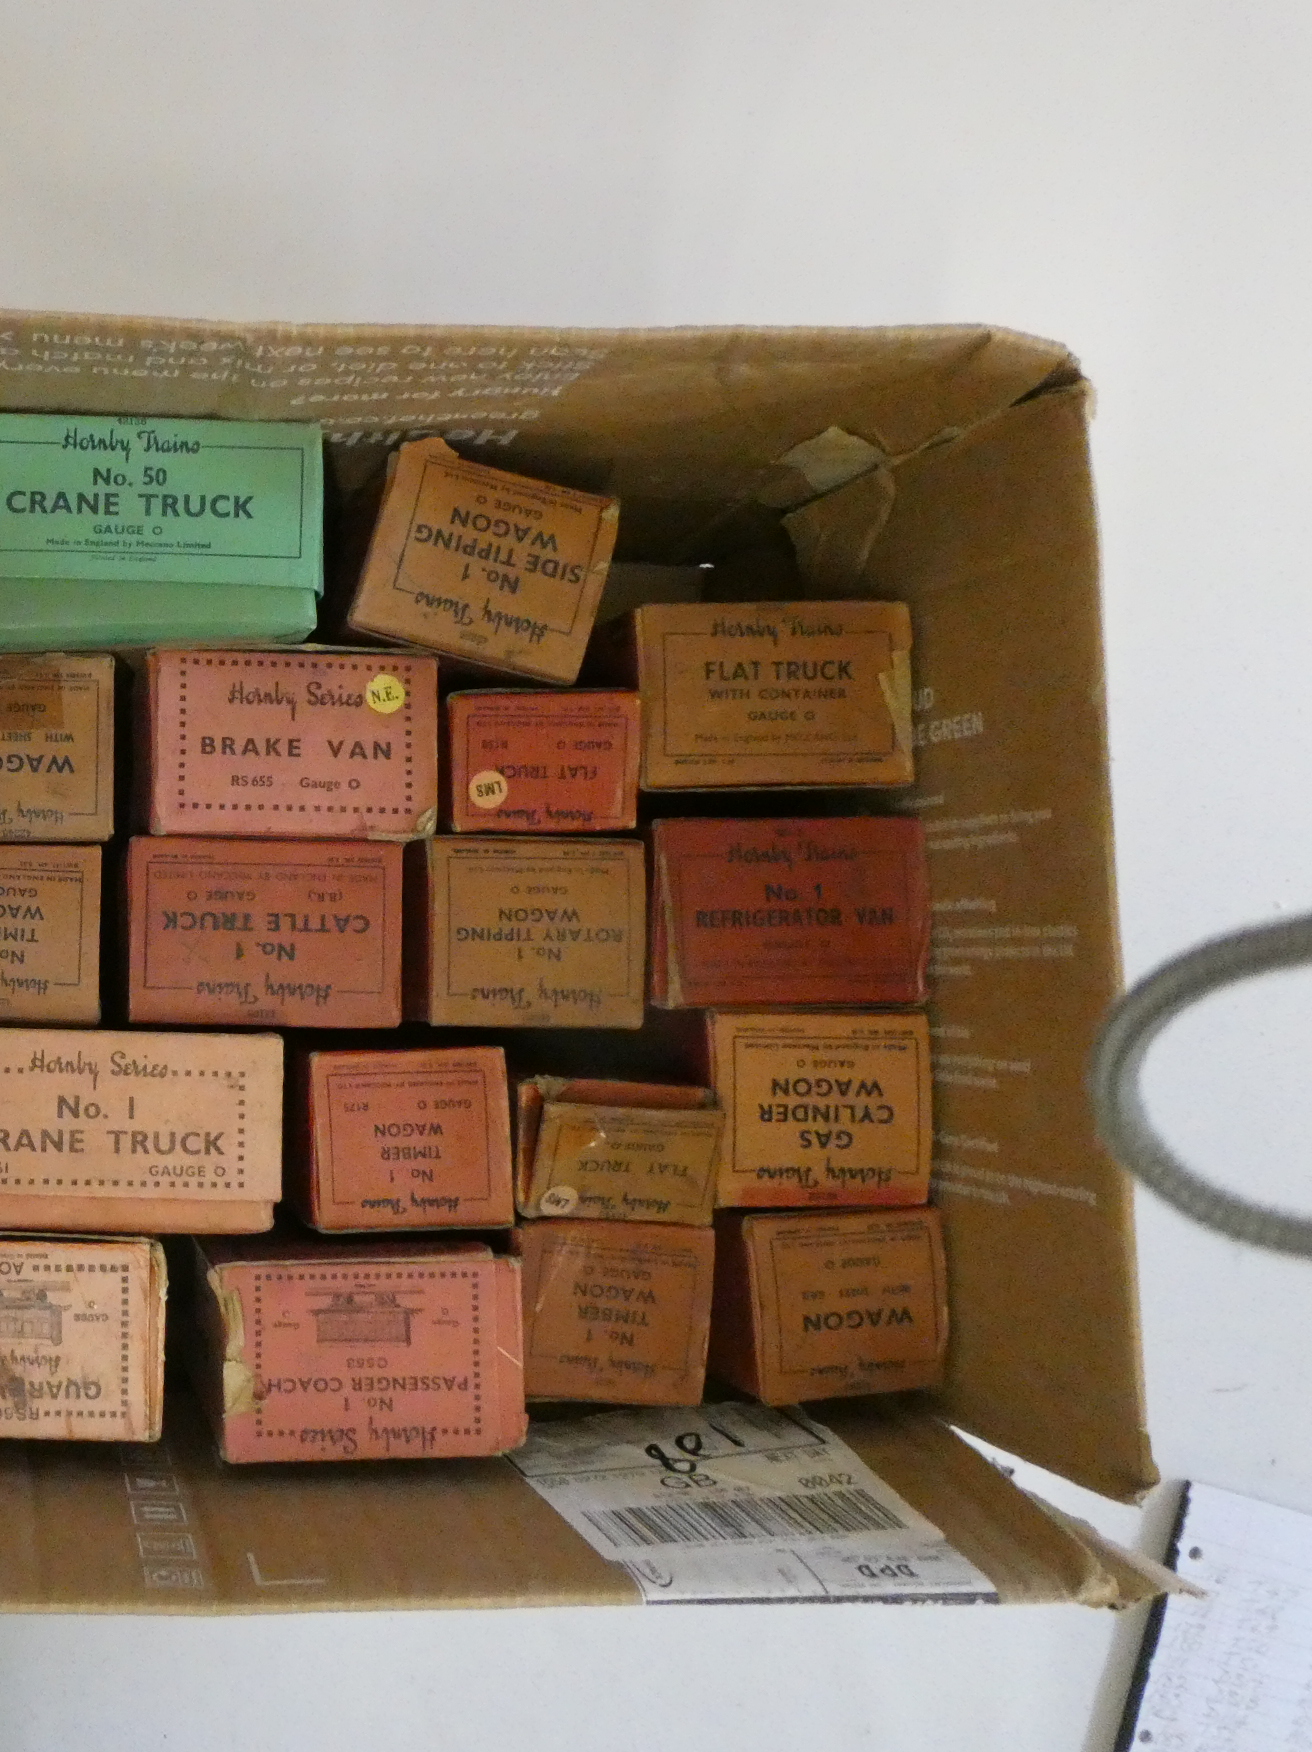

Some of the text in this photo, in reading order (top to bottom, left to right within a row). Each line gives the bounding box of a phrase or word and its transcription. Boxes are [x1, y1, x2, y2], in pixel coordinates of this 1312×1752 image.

[32, 332, 517, 358] here to see next week's menu
[31, 349, 134, 365] match
[146, 355, 208, 369] and
[91, 365, 180, 379] menu
[190, 369, 238, 382] the
[285, 363, 317, 374] or
[330, 362, 398, 374] diet,
[477, 361, 507, 372] to
[251, 378, 287, 390] on
[296, 373, 413, 388] recipes
[418, 373, 476, 384] new
[396, 389, 440, 402] for
[61, 427, 201, 463] Hornby Trains
[92, 467, 167, 487] No. 50
[5, 490, 255, 519] CRANE TRUCK
[494, 499, 543, 520] GAUGE
[92, 524, 164, 536] GAUGE O
[450, 506, 559, 553] WAGON
[45, 537, 69, 547] Made
[84, 538, 119, 550] England
[176, 541, 212, 550] Limited
[414, 523, 583, 585] SIDE TIPPING
[461, 563, 521, 595] No. 1
[414, 592, 549, 645] Hornby Trains
[704, 659, 855, 681] FLAT TRUCK
[228, 680, 364, 721] Hornby Series
[708, 687, 847, 700] WITH CONTAINER
[6, 702, 47, 713] GAUGE
[200, 736, 393, 760] BRAKE VAN
[558, 765, 598, 781] FLAT
[299, 777, 361, 792] Gauge O
[476, 780, 503, 798] LMS
[17, 800, 64, 825] Hornby
[205, 890, 256, 902] GAUGE
[161, 911, 371, 934] CATTLE TRUCK
[498, 907, 581, 923] WAGON
[695, 907, 843, 928] REFRIGERATOR
[455, 926, 624, 943] ROTARY TIPPING
[235, 942, 296, 962] No. 1
[531, 946, 562, 962] No.
[0, 969, 50, 995] Hornby
[197, 972, 332, 1007] Hornby Trains
[470, 976, 602, 1012] Hornby Trains
[28, 1049, 169, 1091] Hornby Series
[770, 1077, 884, 1099] WAGON
[56, 1094, 109, 1120] No.
[434, 1098, 473, 1110] GAUGE
[758, 1104, 895, 1125] CYLINDER
[373, 1122, 444, 1138] WAGON
[106, 1129, 225, 1155] TRUCK
[798, 1129, 853, 1150] GAS
[379, 1145, 442, 1161] TIMBER
[148, 1164, 206, 1178] GAUGE
[214, 1165, 226, 1178] O
[578, 1160, 689, 1178] FLAT TRUCK
[756, 1157, 892, 1189] Hornby Trains
[603, 1266, 652, 1282] GAUGE
[572, 1282, 657, 1305] WAGON
[577, 1305, 649, 1328] TIMBER
[802, 1307, 914, 1333] WAGON
[604, 1330, 635, 1347] No.
[267, 1375, 469, 1394] PASSENGER COACH
[299, 1416, 438, 1456] Hornby Series
[660, 1473, 718, 1490] GB
[857, 1562, 916, 1579] DPD
